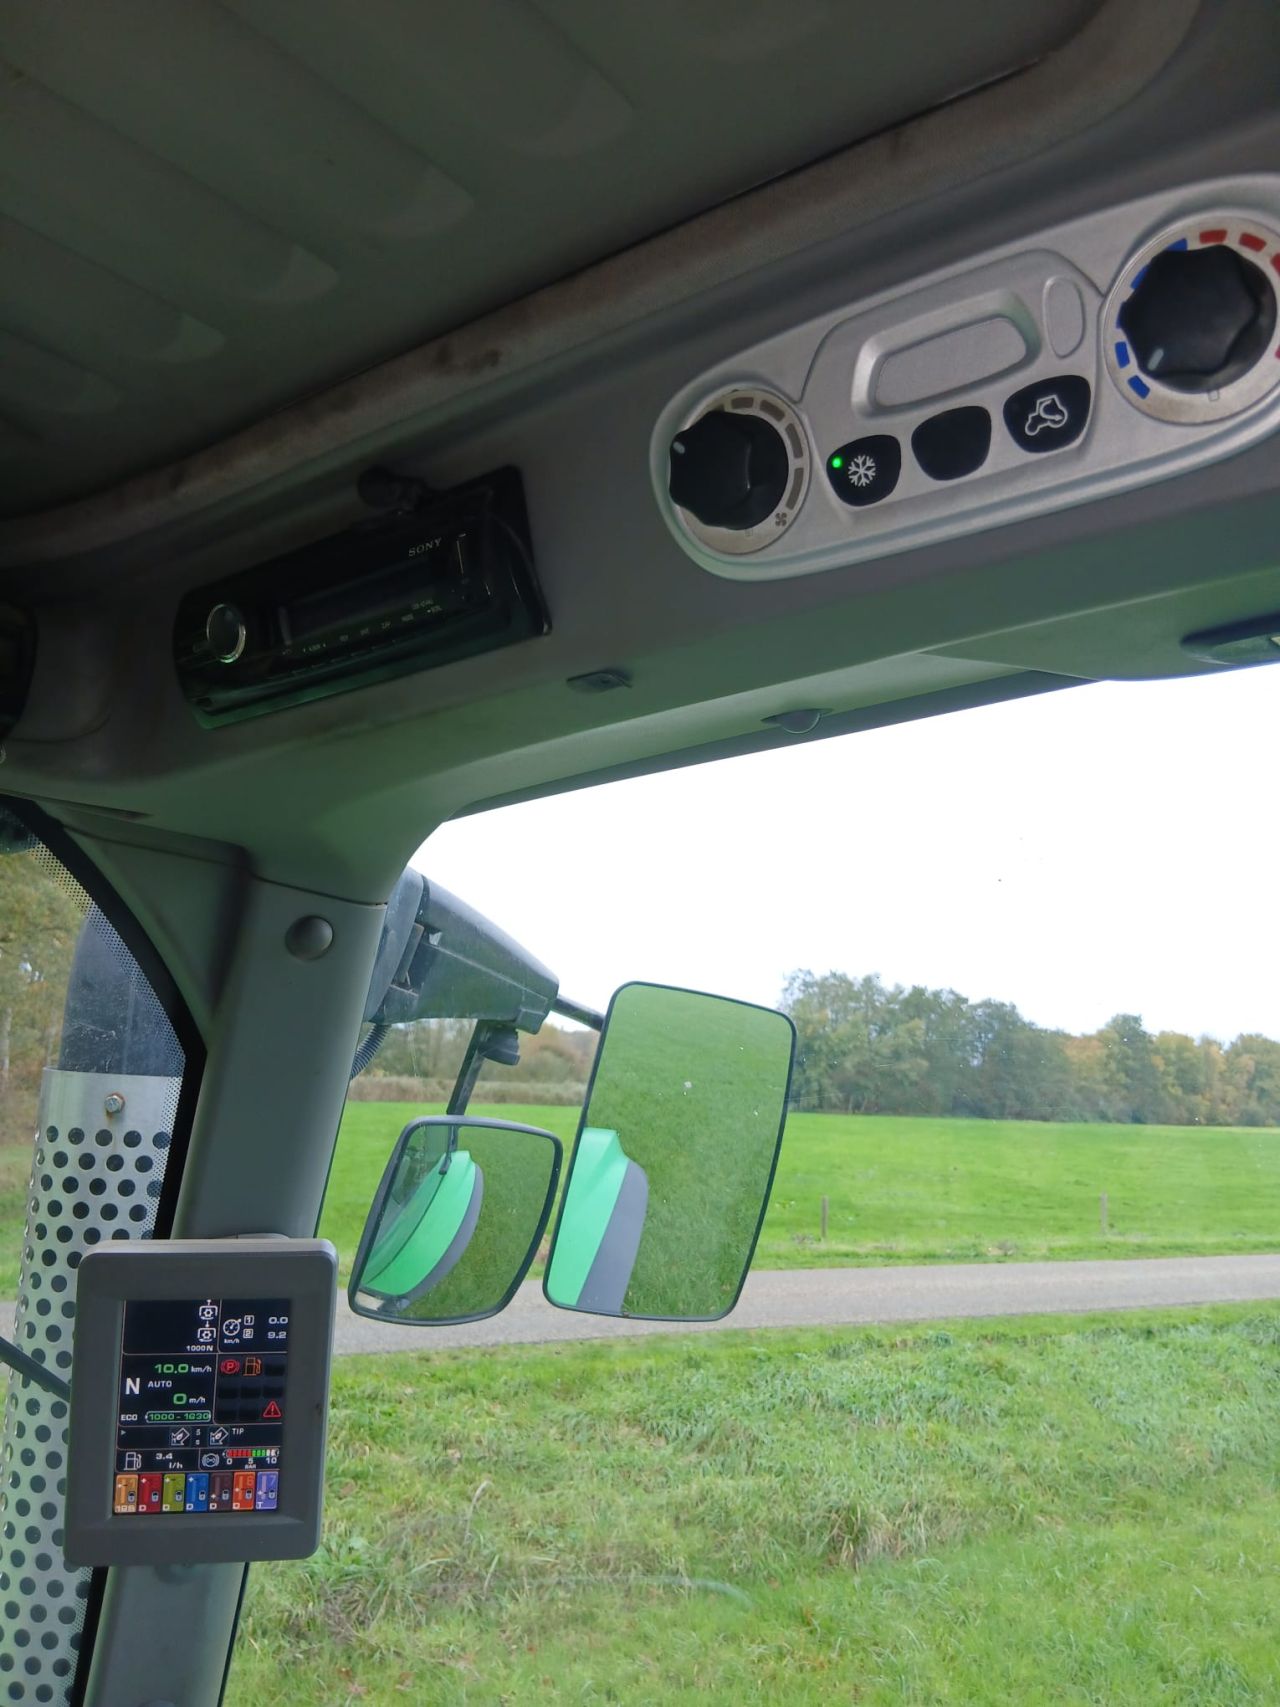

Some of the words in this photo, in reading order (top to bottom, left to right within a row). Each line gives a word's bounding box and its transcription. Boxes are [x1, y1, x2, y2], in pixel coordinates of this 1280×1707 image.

[408, 537, 442, 557] SONY
[154, 1364, 188, 1374] 10.0
[125, 1377, 140, 1395] N
[173, 1393, 187, 1404] 0
